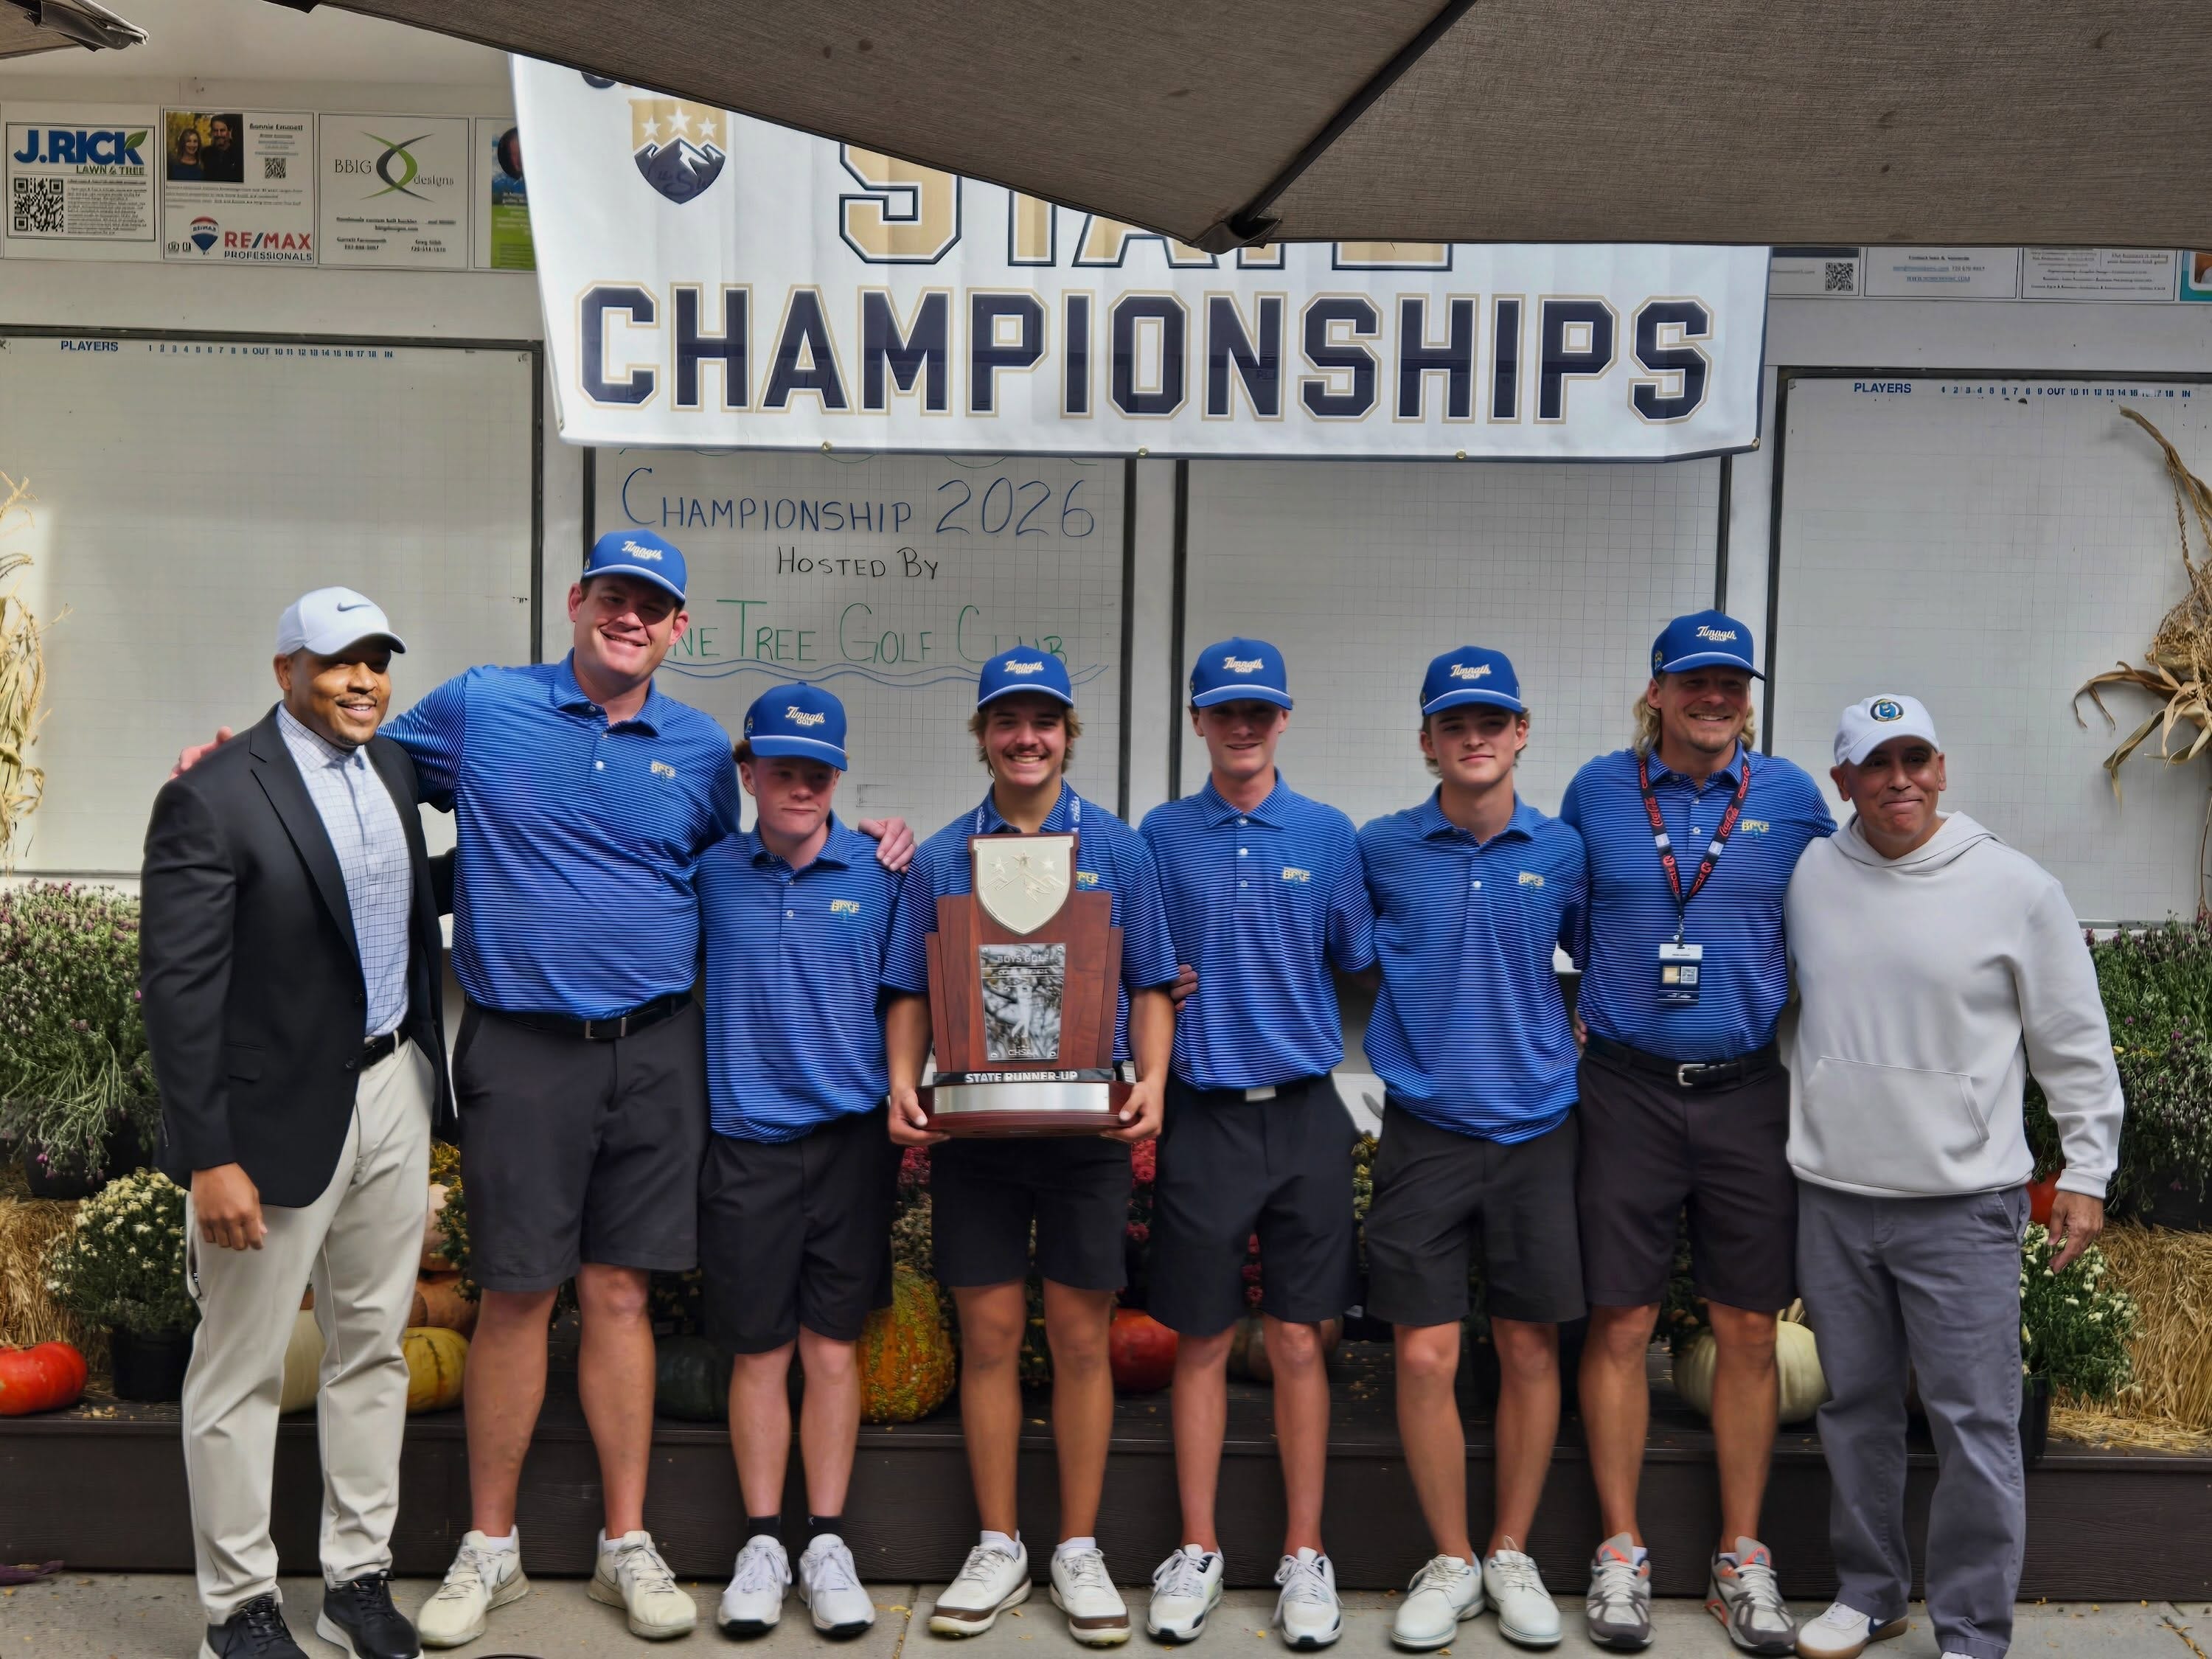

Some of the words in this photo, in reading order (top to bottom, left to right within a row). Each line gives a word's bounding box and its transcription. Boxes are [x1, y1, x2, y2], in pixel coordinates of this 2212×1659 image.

[13, 129, 147, 166] J.RICK
[76, 164, 107, 174] LAWN
[335, 159, 372, 174] BBIG
[224, 231, 311, 250] RE/MAX
[224, 251, 312, 262] PROFESSIONALS
[60, 340, 119, 352] PLAYERS
[574, 280, 1715, 425] CHAMPIONSHIPS
[1854, 382, 1912, 394] PLAYERS
[2047, 387, 2065, 395] OUT
[622, 467, 912, 533] CHAMPIONSHIP
[936, 477, 1096, 538] 2026
[778, 546, 886, 578] HOSTED
[674, 627, 720, 656] NE
[716, 599, 817, 661] TREE
[839, 602, 933, 664] GOLF
[958, 605, 1068, 667] CLB
[965, 1073, 1002, 1083] STATE
[1004, 1071, 1079, 1082] RUNNER-UP
